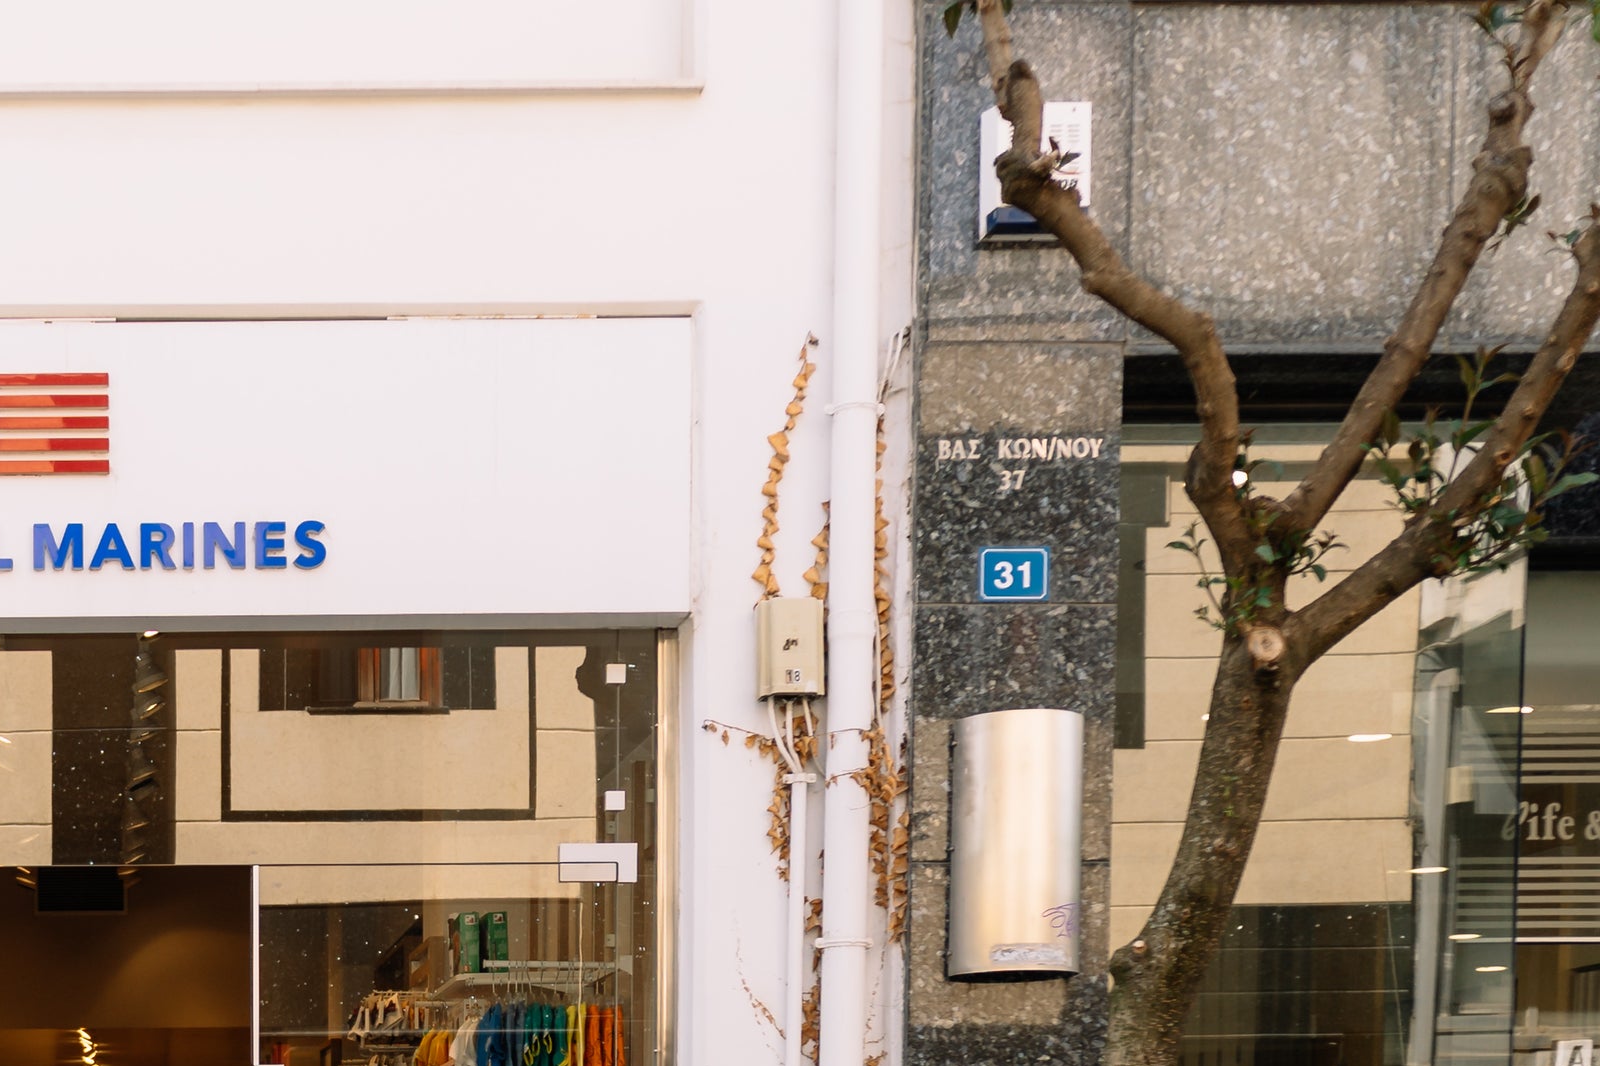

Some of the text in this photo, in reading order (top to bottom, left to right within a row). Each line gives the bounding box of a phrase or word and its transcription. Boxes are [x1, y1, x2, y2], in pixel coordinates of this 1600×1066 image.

[938, 437, 1103, 460] ΒΑΣ ΚΩΝ/ΝΟΥ
[999, 470, 1026, 490] 37
[33, 520, 328, 569] MARINES
[993, 561, 1032, 589] 31
